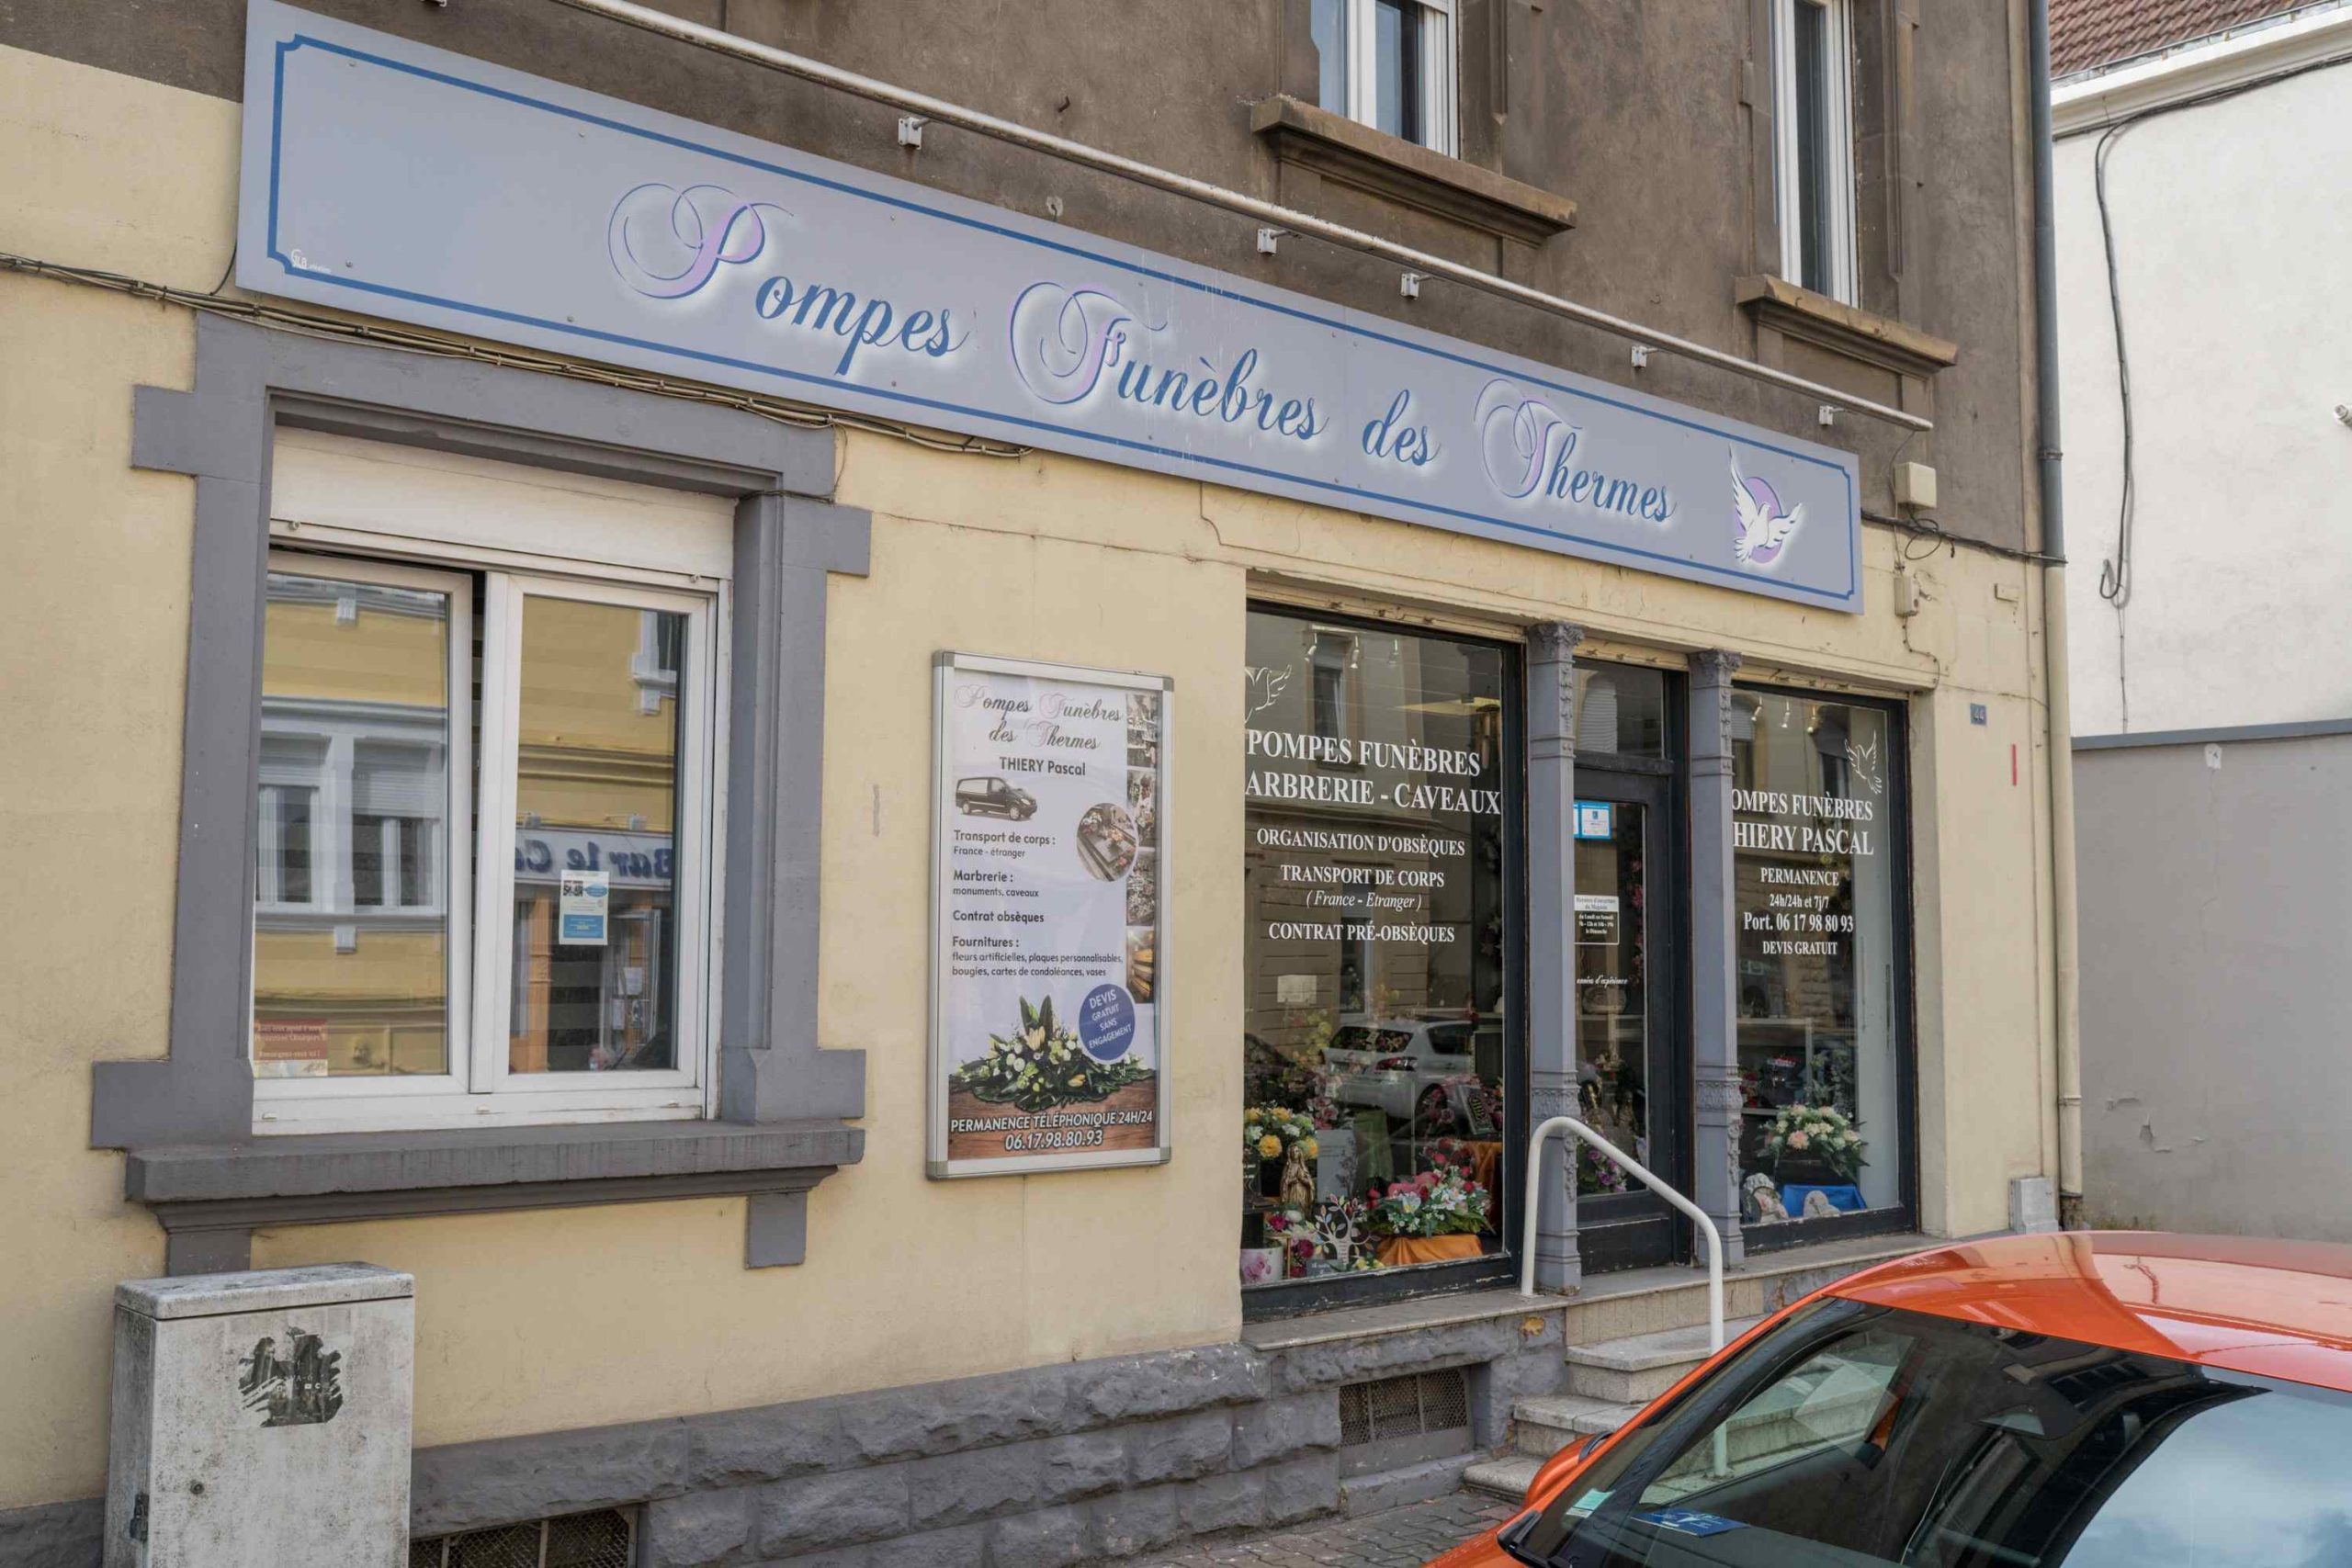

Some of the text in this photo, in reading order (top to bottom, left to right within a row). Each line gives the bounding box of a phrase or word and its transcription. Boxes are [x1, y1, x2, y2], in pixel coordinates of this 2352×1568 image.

[607, 183, 1677, 521] Pompes Funèbres des Thermes
[954, 684, 1123, 721] Pompes Funèbres
[989, 717, 1101, 750] des Thermes
[1247, 728, 1480, 777] POMPES FUNÈBRES
[1000, 756, 1086, 775] THIERY Pascal
[1394, 783, 1501, 816] CAVEAUX
[1792, 791, 1874, 821] FUNÈBRES
[954, 829, 1006, 845] Transport
[1008, 831, 1022, 843] de
[1023, 834, 1050, 847] corps
[1257, 828, 1465, 857] ORGANISATION D'OBSÈQUES
[1802, 827, 1874, 855] PASCAL
[954, 847, 983, 856] France
[990, 847, 1025, 859] étranger
[953, 869, 1008, 883] Marbrerie
[1280, 864, 1444, 887] TRANSPORT DE CORPS
[1760, 867, 1839, 886] PERMANENCE
[953, 887, 1039, 897] monuments, caveaux
[1314, 889, 1355, 907] France
[1366, 892, 1414, 911] Etranger
[1770, 893, 1829, 911] 24h/24h et 7j/7
[953, 910, 1045, 924] Contrat obsèques
[1743, 912, 1854, 933] Port. 06 17 98 80 93
[952, 935, 1014, 948] Fournitures
[1269, 920, 1455, 944] CONTRAT PRÉ-OBSÈQUES
[952, 952, 1123, 964] fleurs artificielles, plaques personnalisables,
[1763, 940, 1838, 955] DEVIS GRATUIT
[952, 966, 1106, 978] bougies, cartes de condoléances, vases
[1090, 988, 1117, 1010] DEVIS
[1091, 1004, 1120, 1021] GRATUIT
[1099, 1018, 1117, 1032] SANS
[1088, 1023, 1132, 1049] ENGAGEMENT
[951, 1111, 1153, 1133] PERMANENCE TÉLÉPHONIQUE 24H/24
[1005, 1129, 1103, 1150] 06.17.98.80.93
